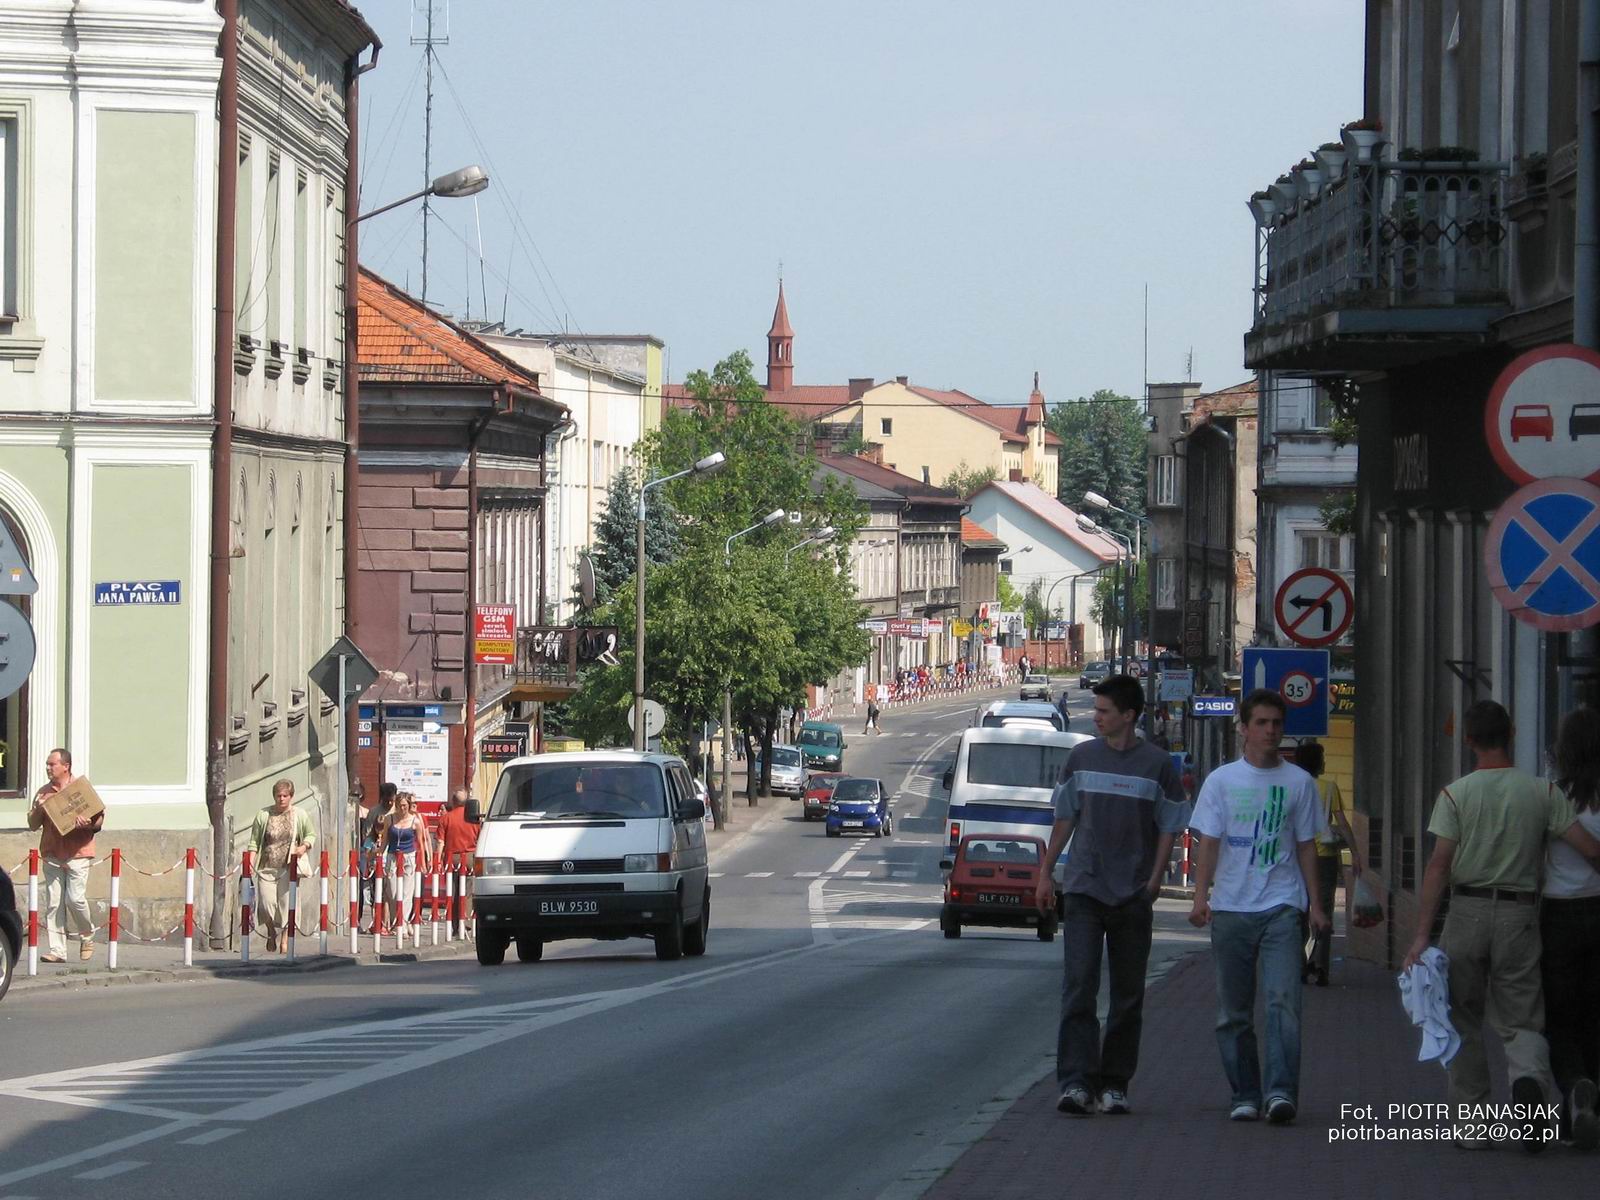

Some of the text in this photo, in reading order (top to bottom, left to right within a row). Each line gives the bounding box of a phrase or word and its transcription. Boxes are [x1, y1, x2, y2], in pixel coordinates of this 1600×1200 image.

[111, 583, 162, 592] PLAC
[98, 591, 177, 603] JANA PAWŁA II
[476, 606, 514, 615] TELEFONY
[483, 615, 505, 623] GSM
[1195, 702, 1234, 711] CASIO
[482, 743, 517, 753] JUKON
[541, 901, 597, 913] BLW 9530
